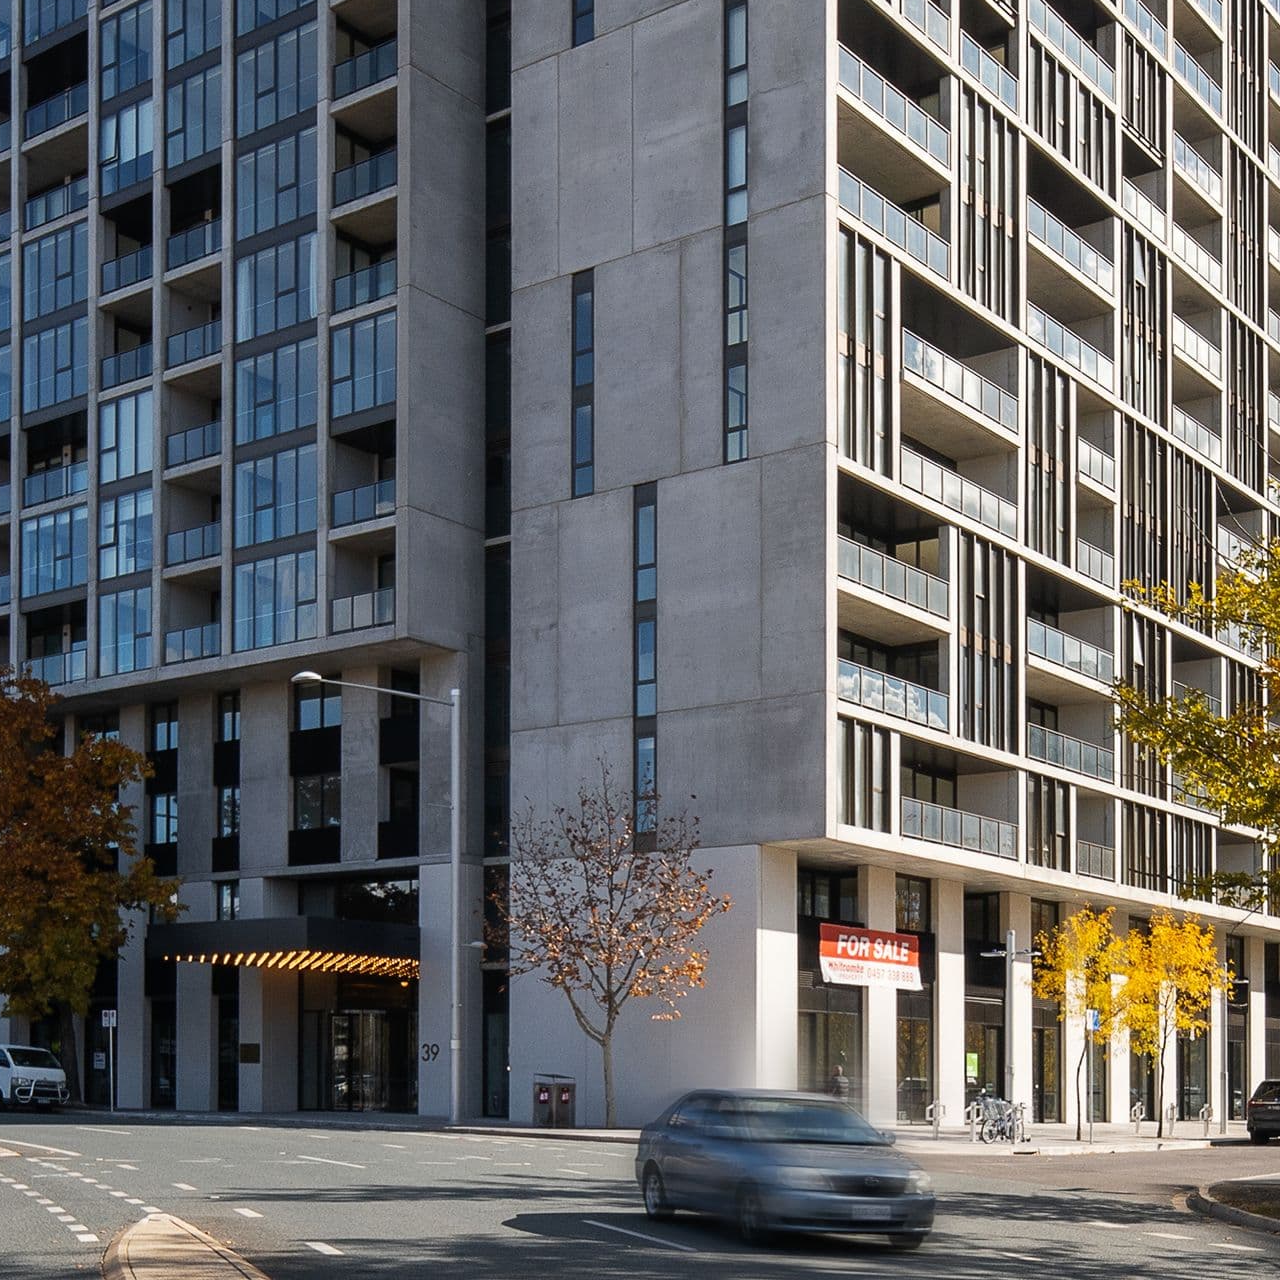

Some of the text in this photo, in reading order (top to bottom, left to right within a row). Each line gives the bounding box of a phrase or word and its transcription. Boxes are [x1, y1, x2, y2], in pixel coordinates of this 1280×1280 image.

[837, 933, 909, 962] FOR SALE
[422, 1043, 440, 1062] 39
